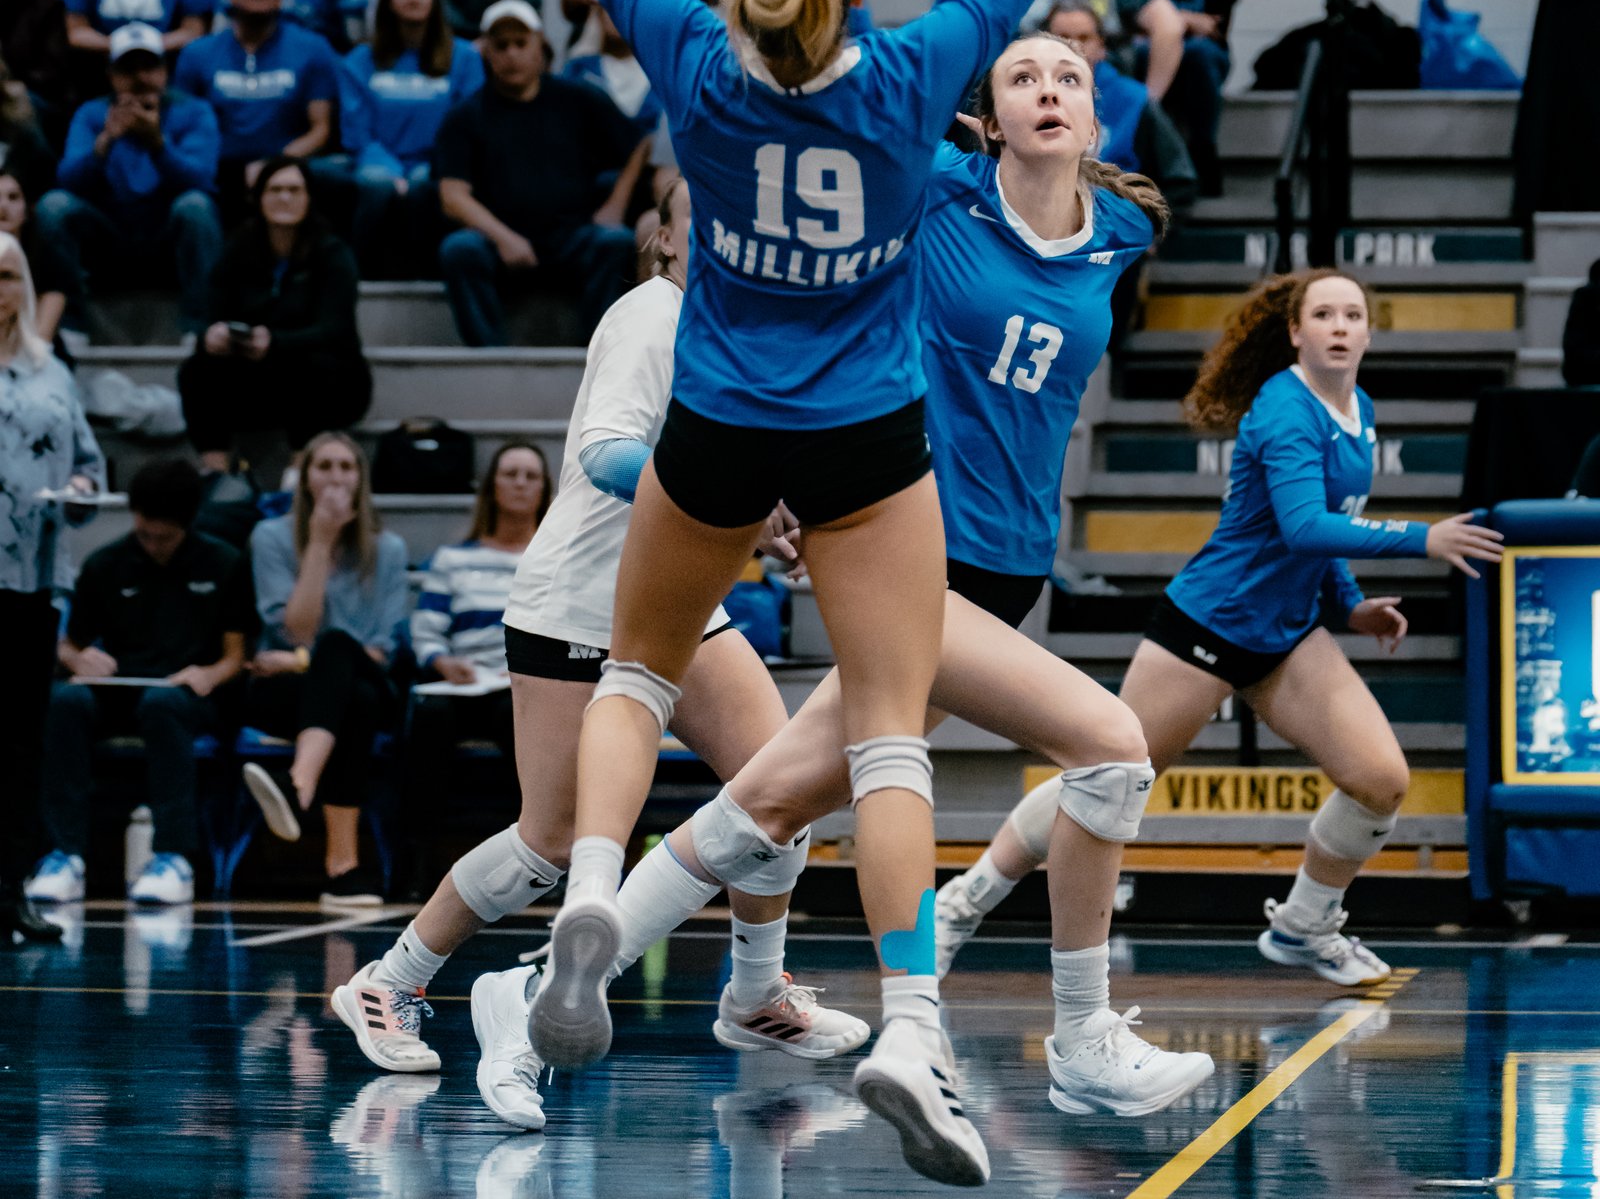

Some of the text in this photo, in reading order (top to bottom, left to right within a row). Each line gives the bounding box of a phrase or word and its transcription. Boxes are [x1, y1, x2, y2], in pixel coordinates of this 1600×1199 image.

[752, 142, 866, 250] 19
[1353, 232, 1437, 269] PARK
[987, 314, 1065, 395] 13
[1166, 773, 1322, 813] VIKINGS
